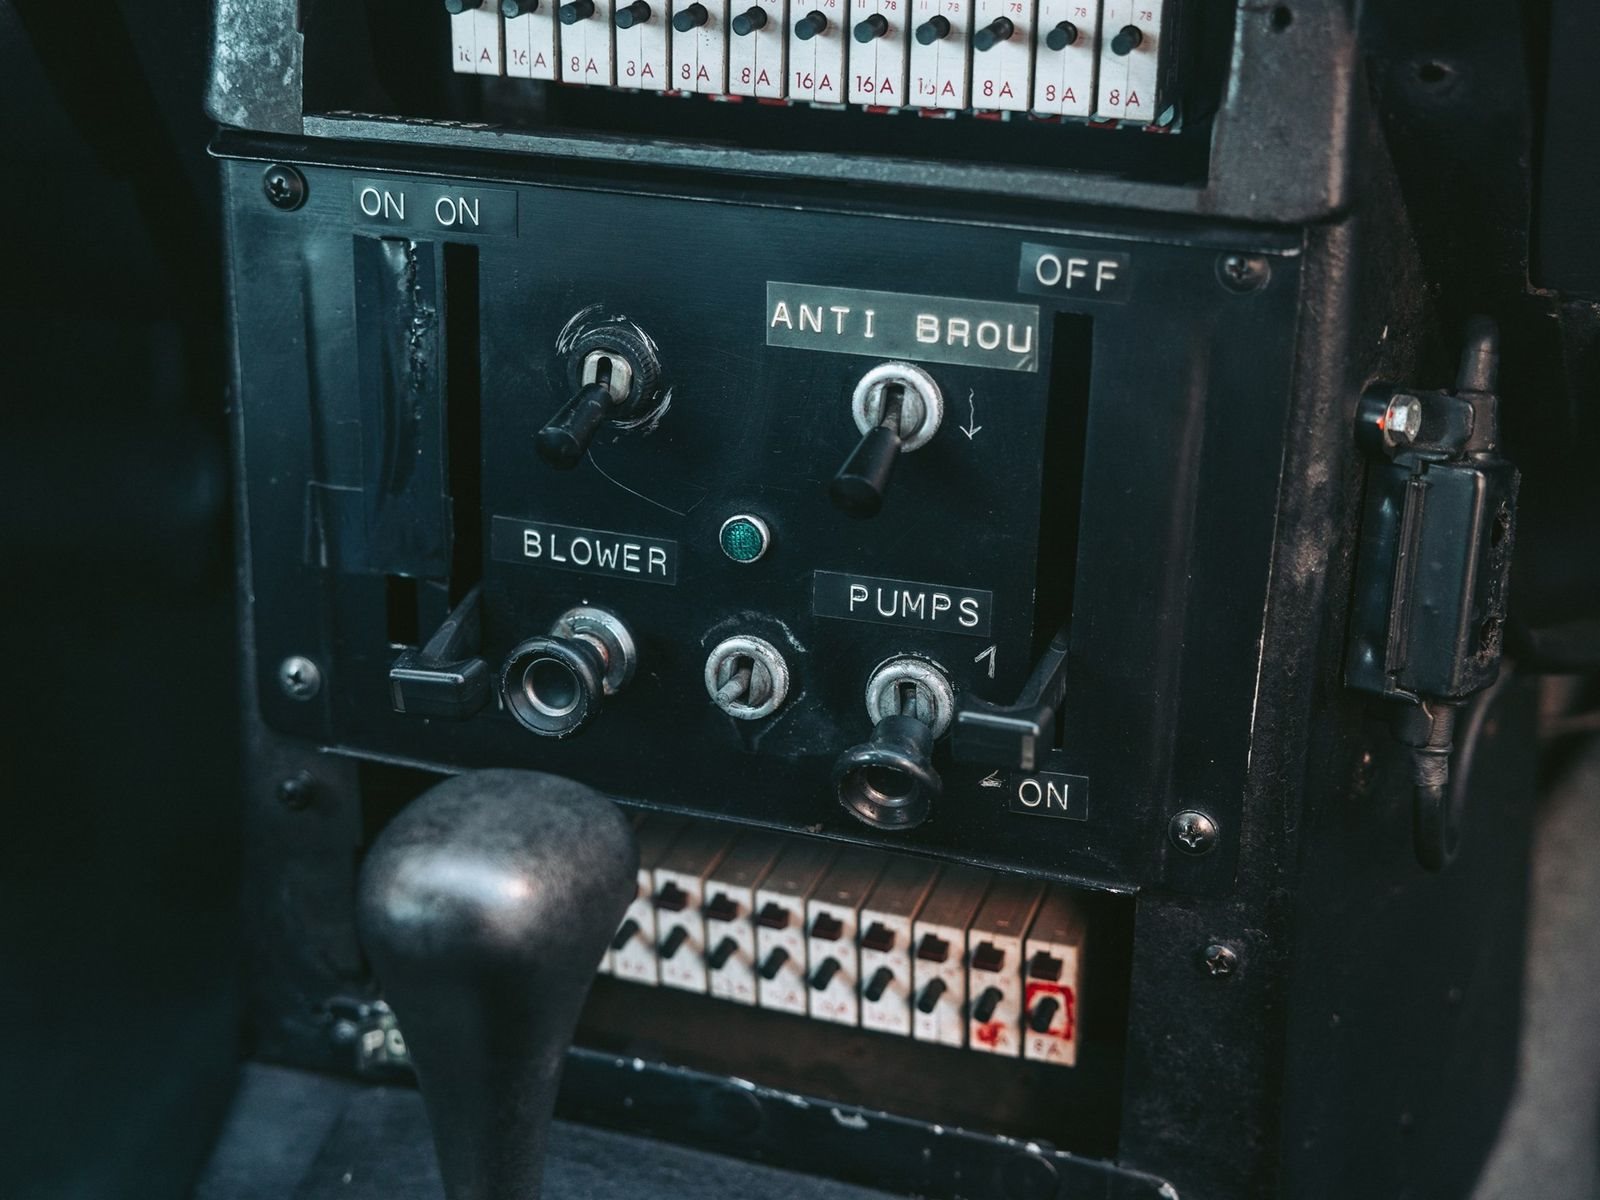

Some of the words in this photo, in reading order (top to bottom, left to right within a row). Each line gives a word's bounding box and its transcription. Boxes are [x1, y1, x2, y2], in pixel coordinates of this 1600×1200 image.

[884, 0, 897, 10] 78
[947, 2, 960, 12] 78
[1009, 3, 1023, 13] 78
[1074, 7, 1087, 17] 78
[1140, 11, 1153, 21] 78
[480, 47, 492, 64] A
[534, 52, 547, 69] A
[571, 56, 579, 73] 8
[585, 57, 598, 74] A
[641, 62, 654, 78] A
[681, 63, 691, 80] 8
[697, 65, 710, 82] A
[741, 67, 751, 84] 8
[756, 69, 770, 86] A
[796, 72, 814, 89] 16
[819, 74, 833, 91] A
[856, 75, 874, 93] 16
[880, 77, 894, 94] A
[941, 80, 956, 96] A
[983, 80, 993, 97] 8
[999, 81, 1014, 98] A
[1046, 84, 1056, 101] 8
[1061, 87, 1077, 103] A
[1109, 88, 1120, 106] 8
[1125, 90, 1140, 107] A
[360, 187, 405, 220] ON
[435, 197, 480, 226] ON
[1035, 253, 1119, 292] OFF
[771, 301, 875, 338] ANTI
[916, 313, 1032, 353] BROU
[523, 529, 667, 576] BLOWER
[849, 584, 979, 627] PUMPS
[1018, 778, 1069, 811] ON
